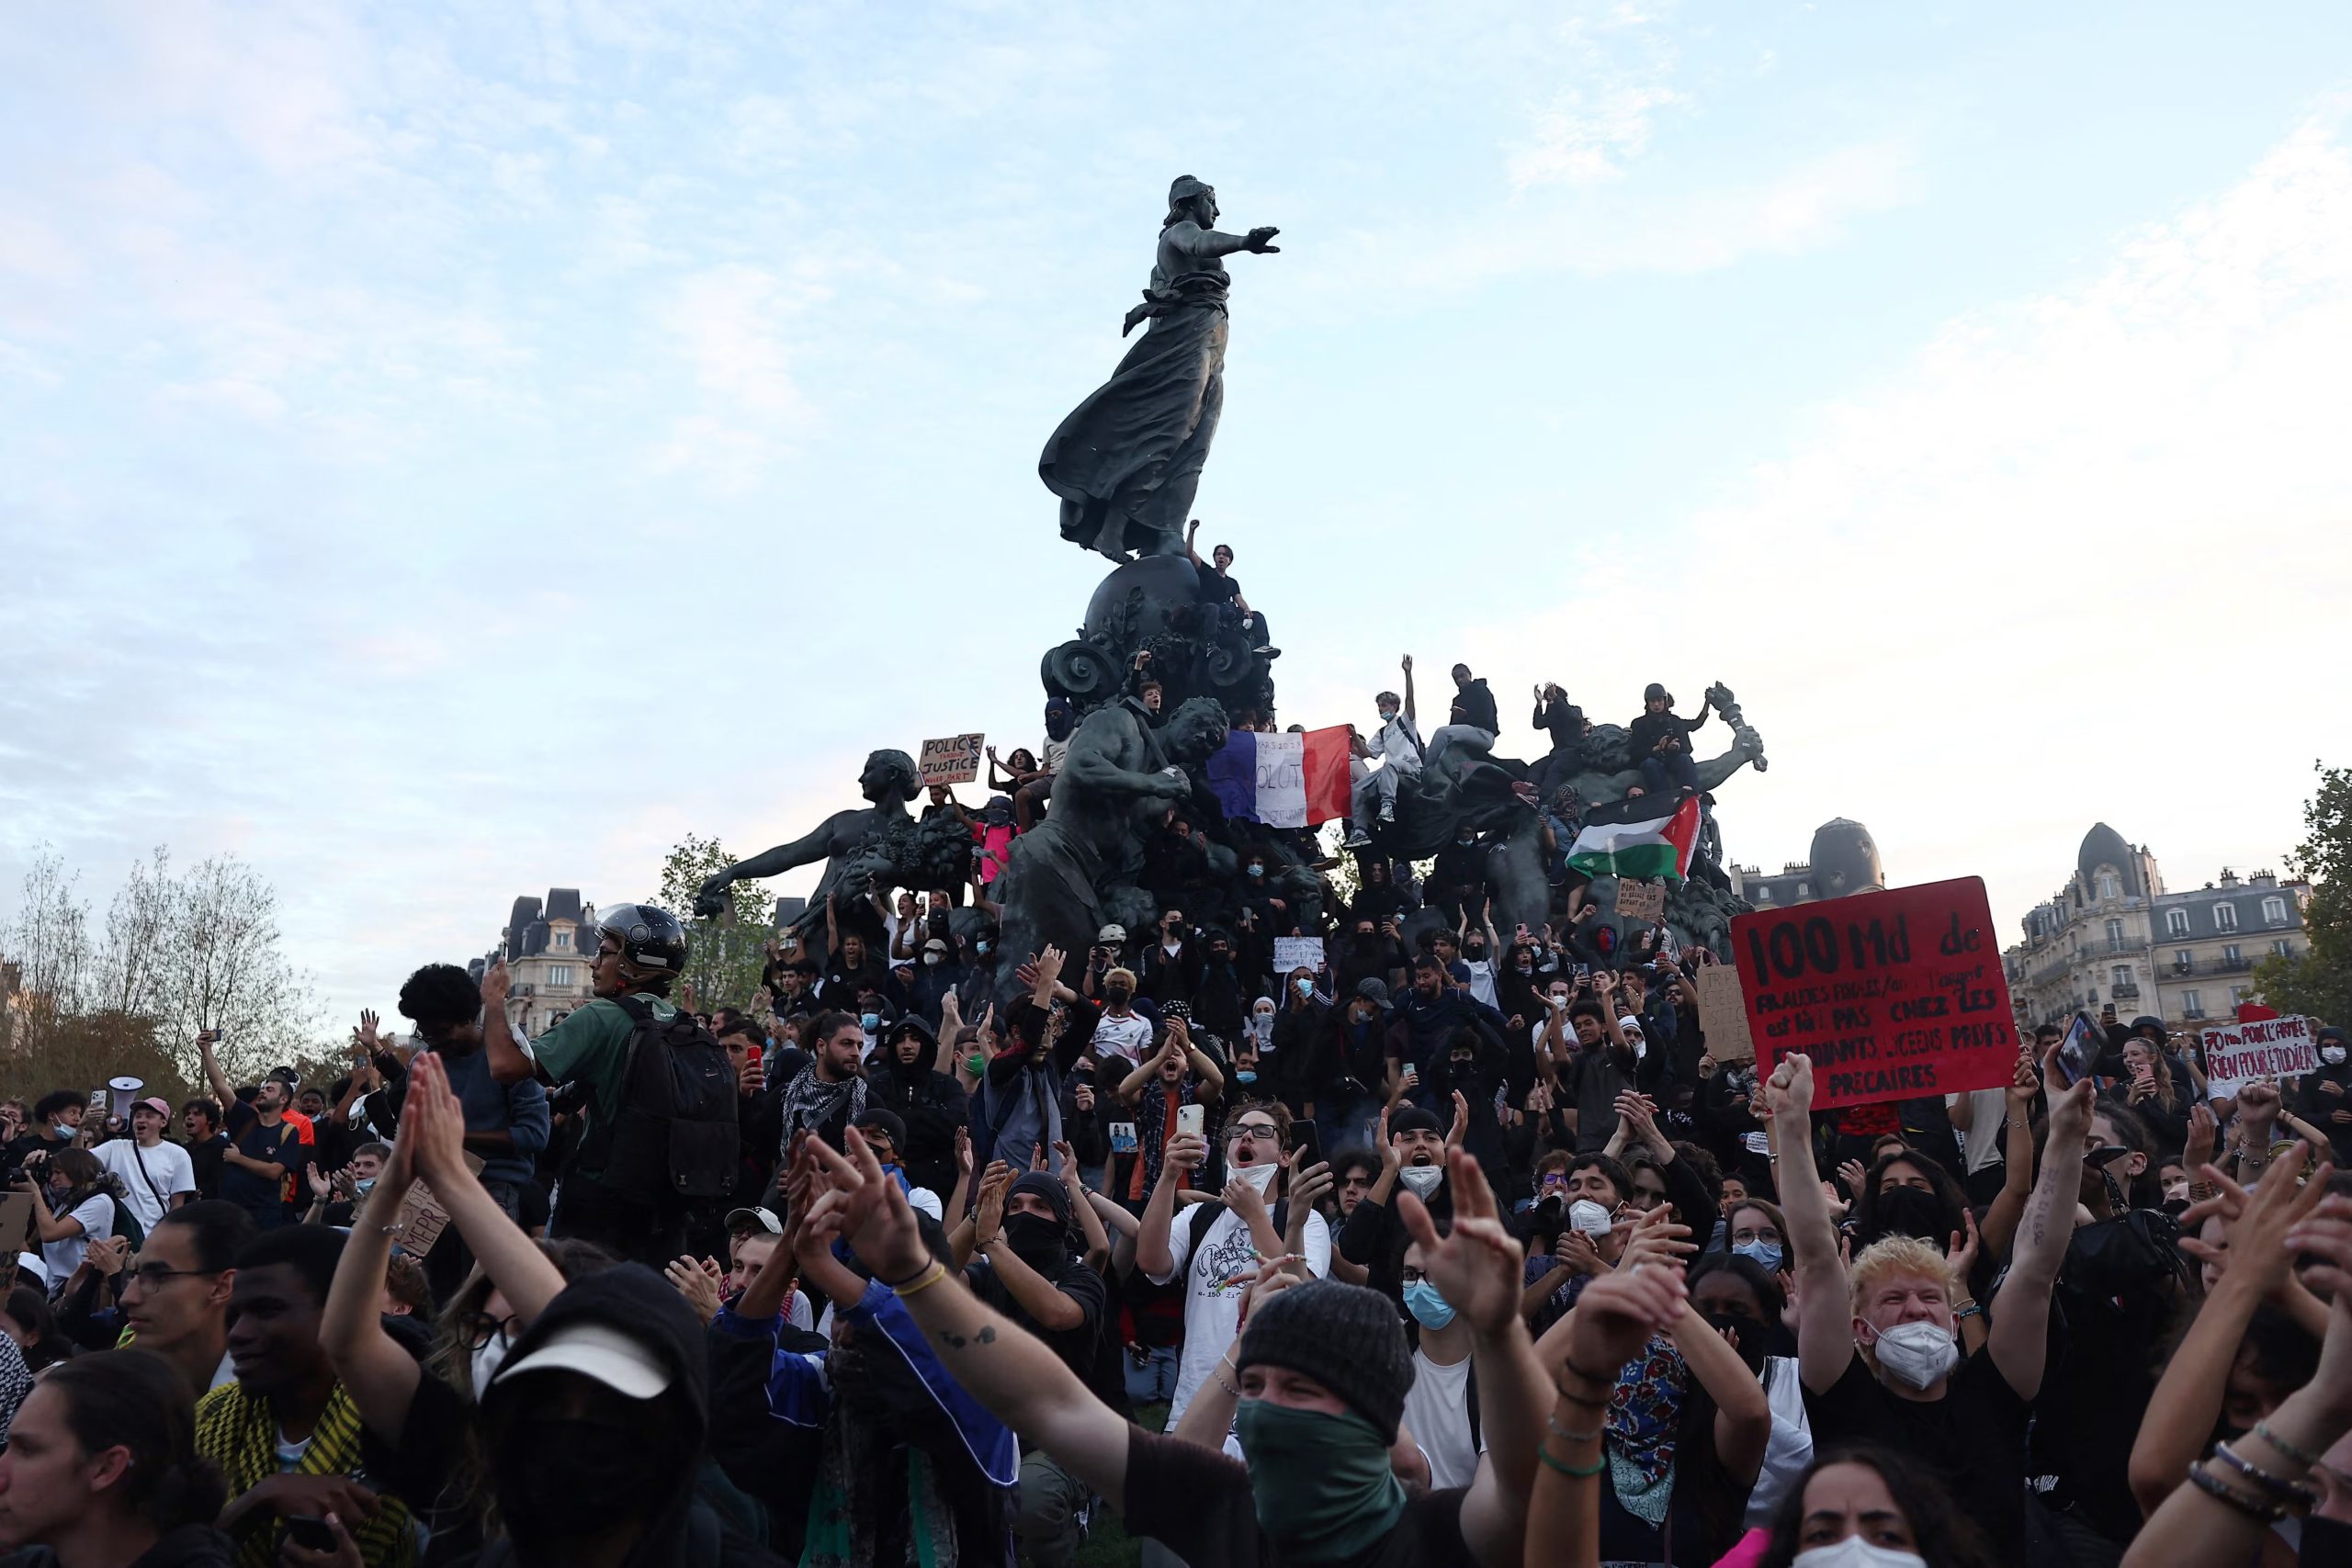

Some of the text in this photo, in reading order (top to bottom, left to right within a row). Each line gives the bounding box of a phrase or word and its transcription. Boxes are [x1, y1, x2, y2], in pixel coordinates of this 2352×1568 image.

[924, 735, 980, 757] POLICE
[1747, 911, 1984, 987] 100 Md de
[1756, 986, 1830, 1014] FRAUDES
[1767, 1016, 1790, 1037] est
[1832, 1006, 1872, 1032] PAS
[1891, 996, 1951, 1022] CHEZ
[1951, 1021, 2007, 1050] PROFS
[2242, 1024, 2267, 1045] POUR
[2239, 1049, 2267, 1077] POUR
[2039, 1474, 2059, 1494] NBA
